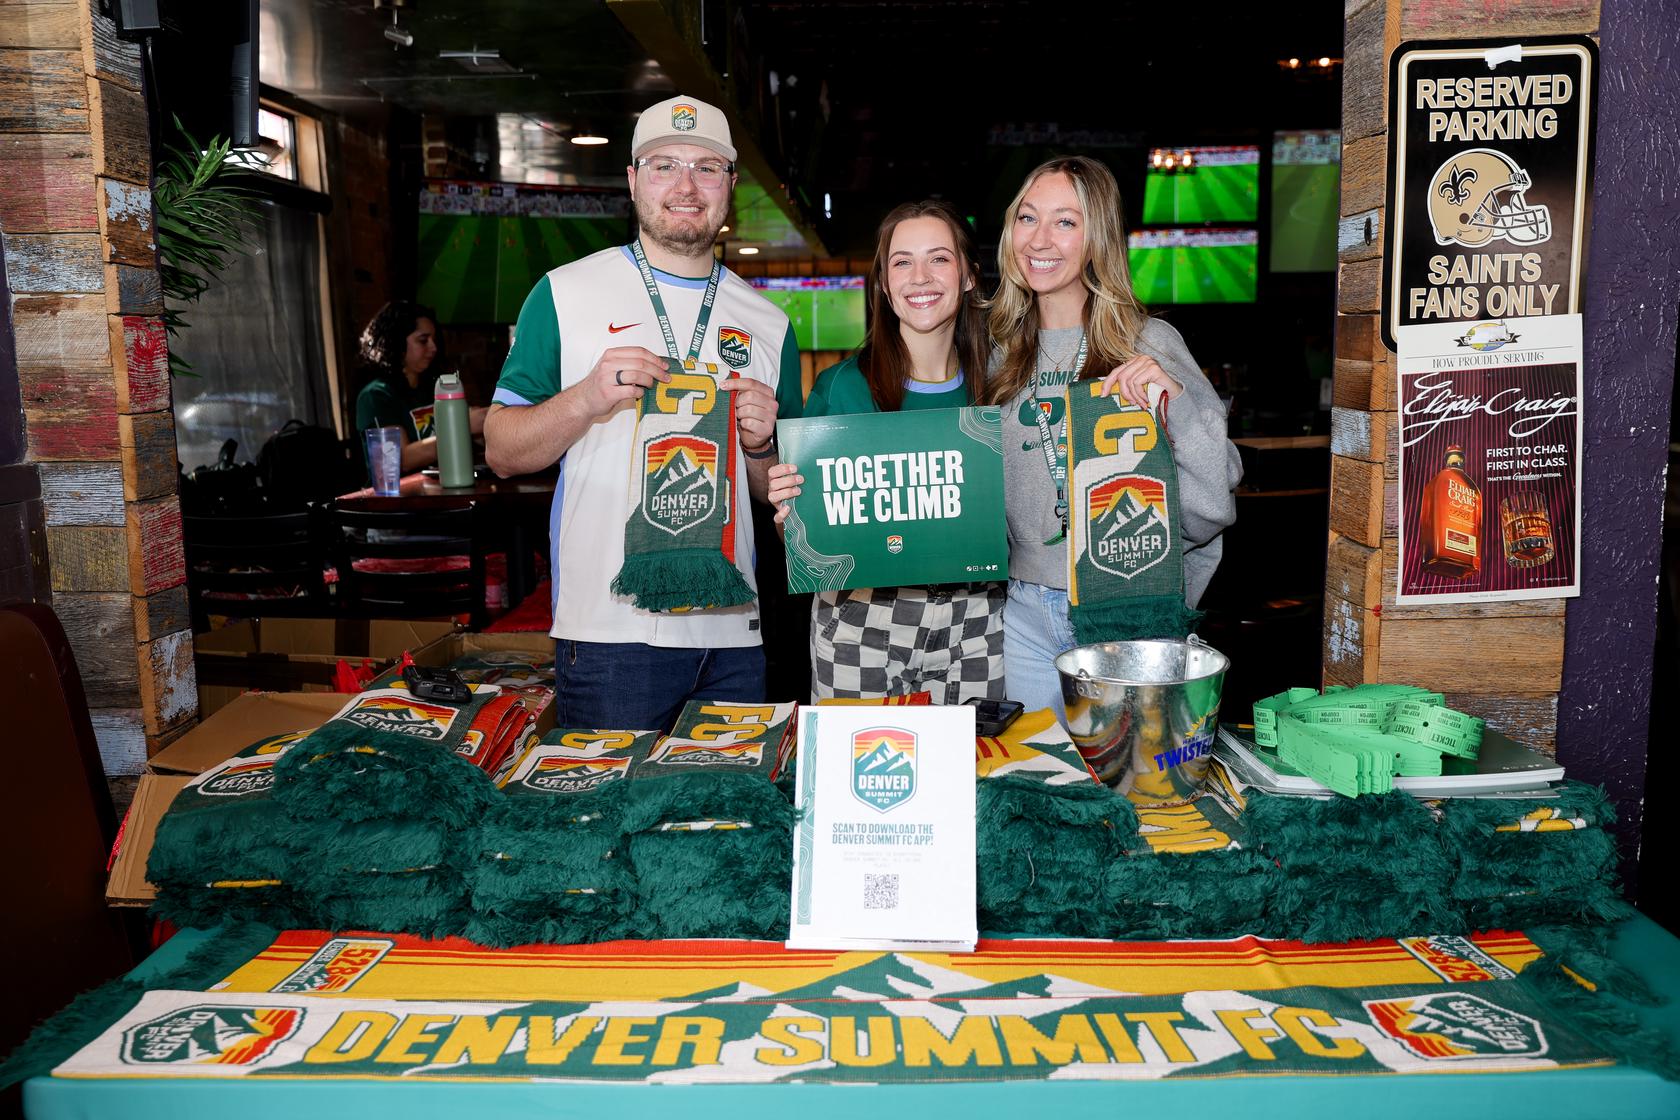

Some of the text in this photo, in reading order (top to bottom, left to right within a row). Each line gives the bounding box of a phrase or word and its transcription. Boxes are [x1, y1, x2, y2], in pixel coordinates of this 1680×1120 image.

[1416, 74, 1573, 109] RESERVED
[1429, 108, 1559, 142] PARKING
[638, 258, 656, 287] SUMMIT
[649, 286, 658, 296] FC
[1427, 253, 1542, 285] SAINTS
[704, 283, 716, 308] DENVER
[1409, 284, 1560, 319] FANS ONLY
[658, 315, 674, 345] DENVER
[697, 323, 706, 334] FC
[722, 348, 746, 361] DENVER
[1432, 351, 1544, 369] NOW PROUDLY SERVING
[1403, 373, 1485, 447] Elijah
[1037, 413, 1051, 441] DENVER
[1486, 444, 1568, 458] FIRST TO CHAR.
[816, 450, 964, 492] TOGETHER
[1486, 457, 1568, 471] FIRST IN CLASS.
[1448, 488, 1475, 507] CRAIG
[1449, 479, 1475, 498] ELIJAH
[651, 494, 708, 511] DENVER
[822, 484, 962, 526] WE CLIMB
[657, 509, 700, 518] SUMMIT
[671, 517, 683, 525] FC
[1099, 535, 1162, 556] DENVER
[1108, 550, 1154, 563] SUMMIT
[1124, 560, 1136, 568] FC
[351, 712, 434, 737] DENVER
[690, 705, 777, 741] FC
[1394, 724, 1416, 735] TICKET
[1431, 733, 1456, 747] TICKET
[858, 774, 909, 790] DENVER
[832, 822, 934, 834] SCAN TO DOWNLOAD THE
[832, 833, 934, 846] DENVER SUMMIT FC APP!
[319, 942, 349, 961] DENVER
[326, 949, 382, 975] 528
[1427, 955, 1490, 982] 528
[142, 1011, 217, 1059] DENVER
[1448, 1001, 1529, 1050] DENVER
[302, 1006, 1367, 1067] DENVER SUMMIT FC
